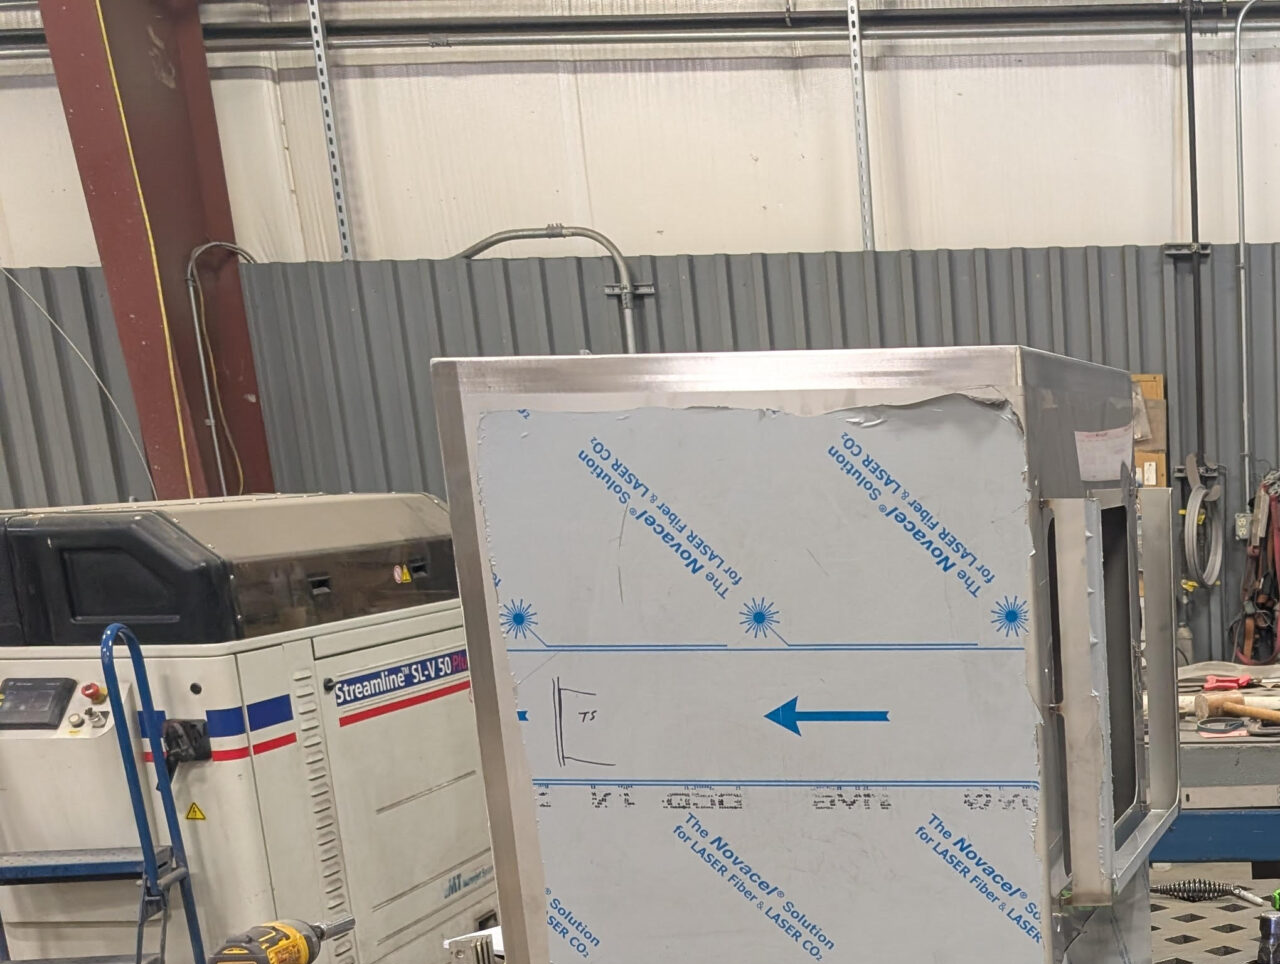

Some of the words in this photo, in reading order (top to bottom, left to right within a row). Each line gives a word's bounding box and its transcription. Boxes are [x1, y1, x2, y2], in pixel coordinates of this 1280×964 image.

[578, 449, 631, 504] Solution
[611, 458, 650, 498] LASER
[828, 446, 882, 501] Solution
[861, 454, 902, 494] LASER
[650, 493, 658, 504] &
[901, 489, 910, 500] &
[656, 503, 687, 534] Fiber
[908, 500, 940, 531] Fiber
[686, 530, 725, 569] LASER
[938, 527, 978, 567] LASER
[705, 571, 729, 600] The
[723, 567, 743, 586] for
[957, 569, 983, 598] The
[976, 564, 996, 584] for
[411, 658, 436, 683] SL-V
[438, 657, 451, 674] 50
[578, 710, 597, 722] TS
[928, 813, 952, 840] The
[673, 825, 692, 843] for
[690, 841, 729, 877] LASER
[728, 874, 758, 902] Fiber
[757, 901, 765, 910] &
[765, 907, 803, 942] LASER
[685, 812, 709, 839] The
[782, 901, 835, 950] Solution
[915, 826, 934, 844] for
[932, 842, 971, 878] LASER
[969, 875, 1001, 903] Fiber
[998, 902, 1007, 912] &
[546, 913, 569, 939] SER
[549, 898, 600, 947] Solution
